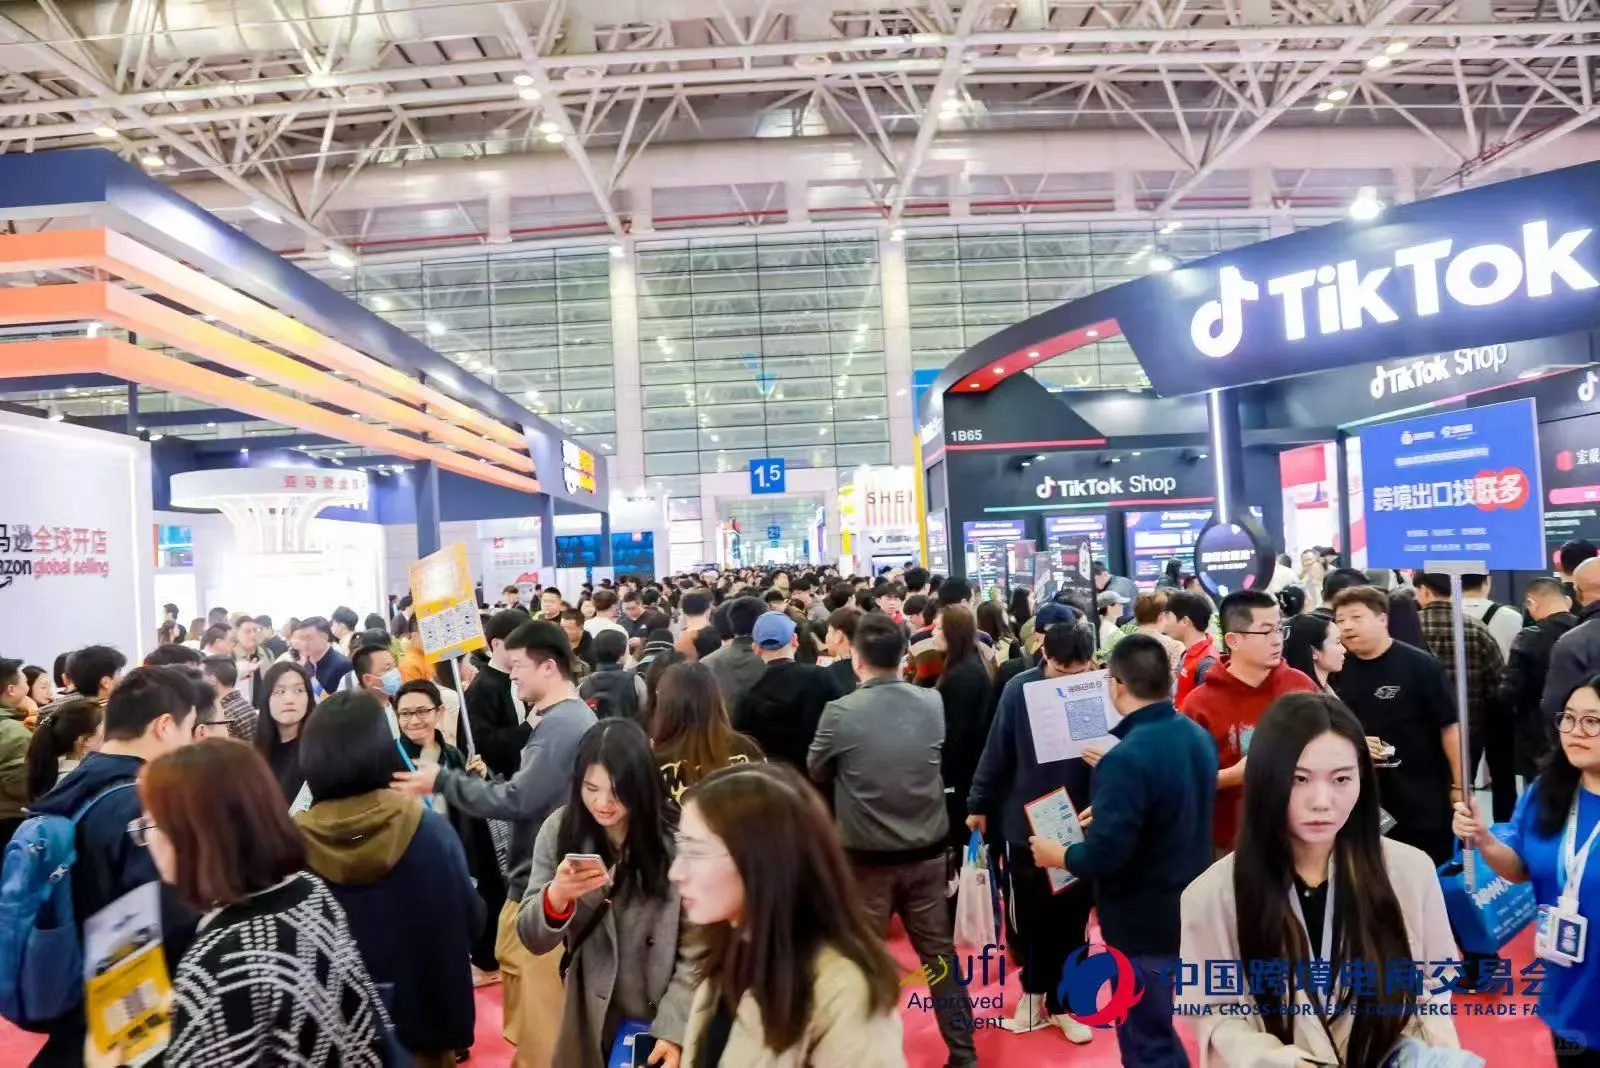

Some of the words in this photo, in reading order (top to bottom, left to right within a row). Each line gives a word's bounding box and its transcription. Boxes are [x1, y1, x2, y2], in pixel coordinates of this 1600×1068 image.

[1269, 221, 1600, 341] TikTok
[1386, 356, 1450, 393] TikTok
[1453, 344, 1507, 375] Shop
[951, 430, 982, 441] 1B65
[753, 465, 781, 488] 1.5
[1057, 477, 1124, 496] TikTok
[1129, 475, 1176, 495] Shop
